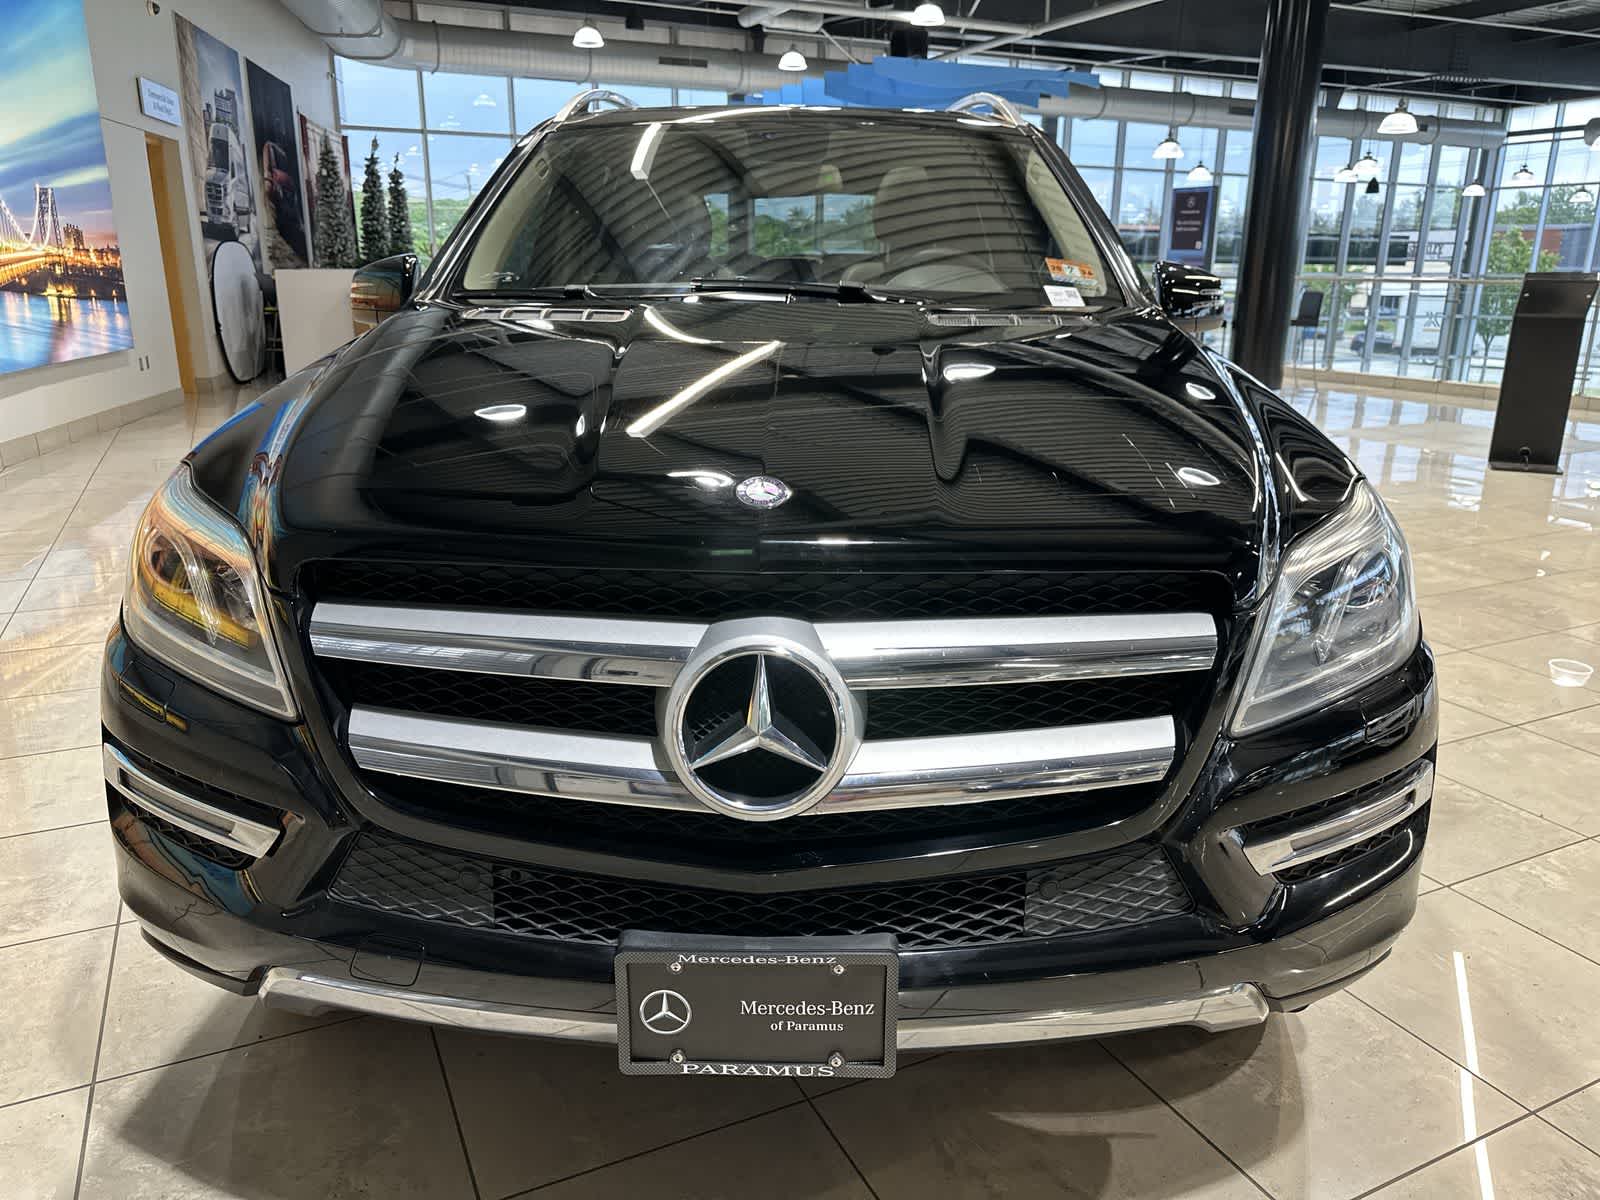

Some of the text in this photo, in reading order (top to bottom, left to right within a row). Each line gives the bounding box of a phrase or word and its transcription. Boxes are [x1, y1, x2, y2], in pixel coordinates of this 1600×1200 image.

[678, 954, 838, 965] Mercedes-Benz
[740, 1000, 875, 1016] Mercedes-Benz
[770, 1021, 844, 1032] of Paramus
[681, 1063, 836, 1077] PARAMUS
